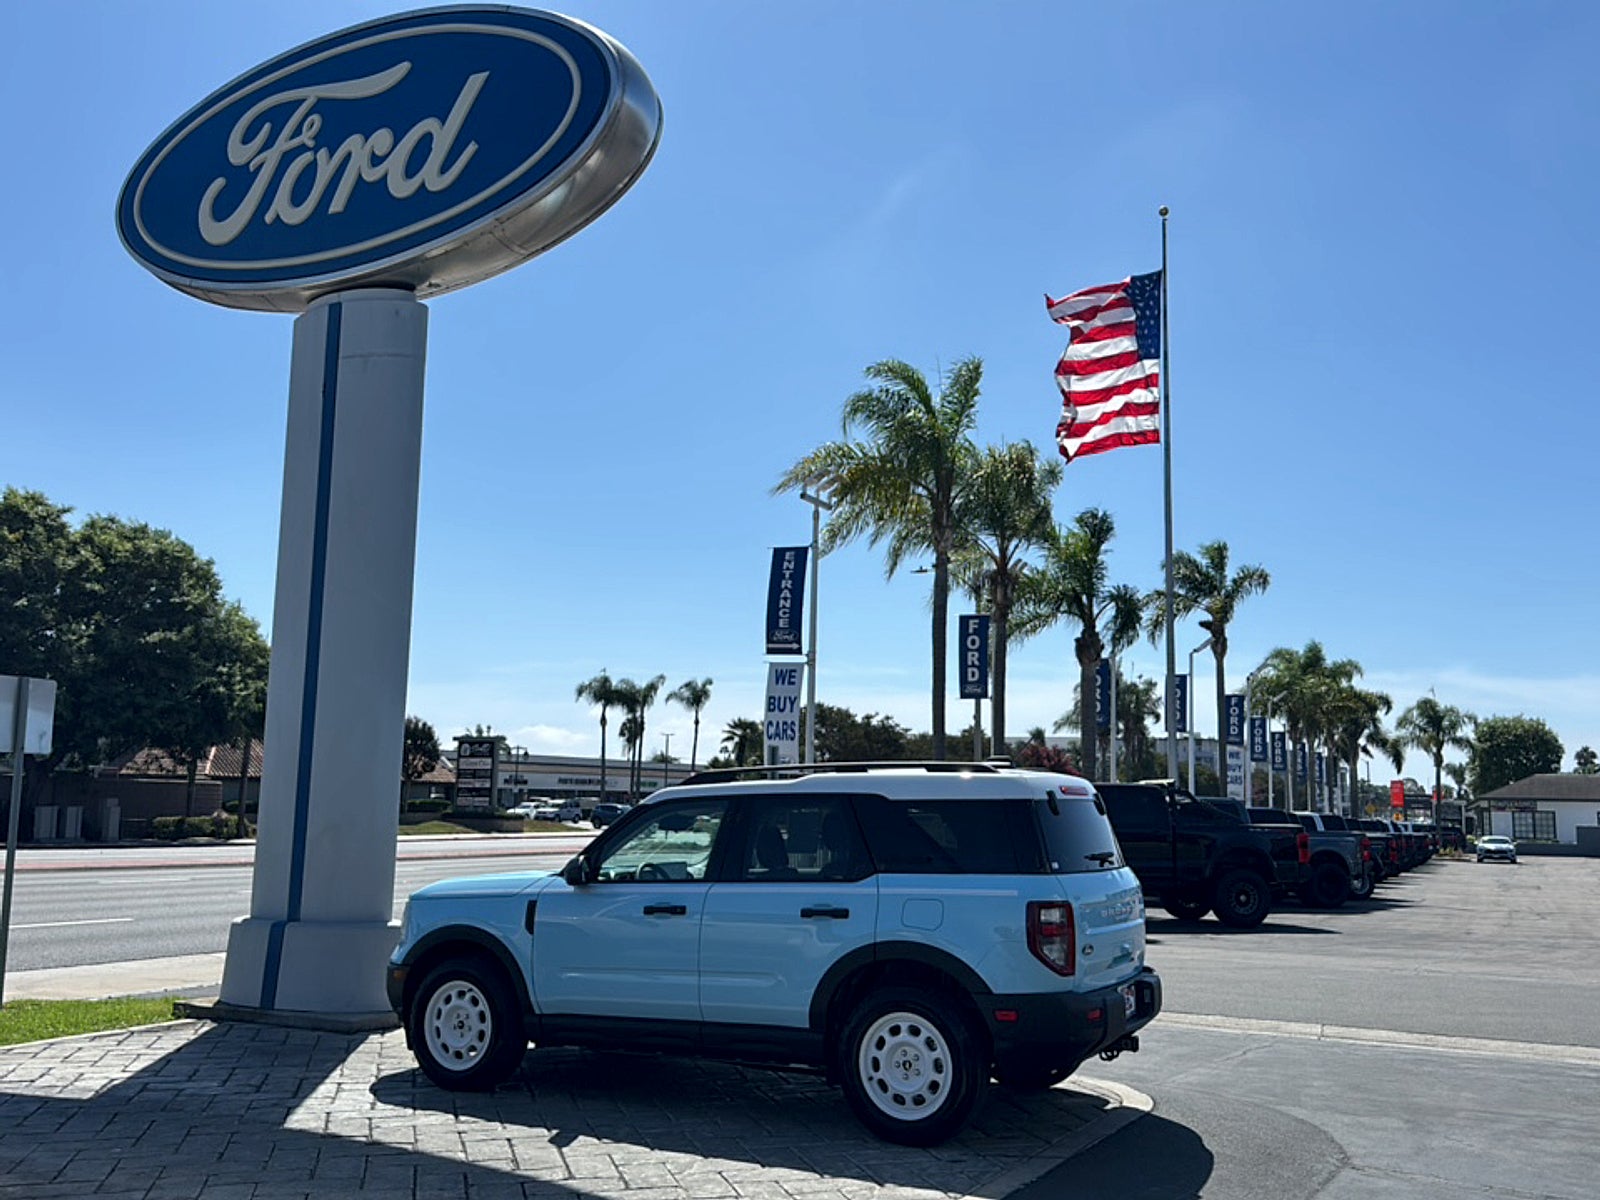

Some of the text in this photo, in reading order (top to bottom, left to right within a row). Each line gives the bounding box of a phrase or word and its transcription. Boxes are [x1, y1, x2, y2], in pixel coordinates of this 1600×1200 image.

[199, 61, 489, 246] Ford
[778, 551, 795, 628] ENTRANCE
[966, 619, 980, 682] FORD
[775, 669, 797, 685] WE
[768, 696, 798, 713] BUY
[1229, 697, 1240, 735] FORD
[766, 721, 796, 741] CARS
[1253, 719, 1263, 753] FORD
[1273, 733, 1282, 763] FORD
